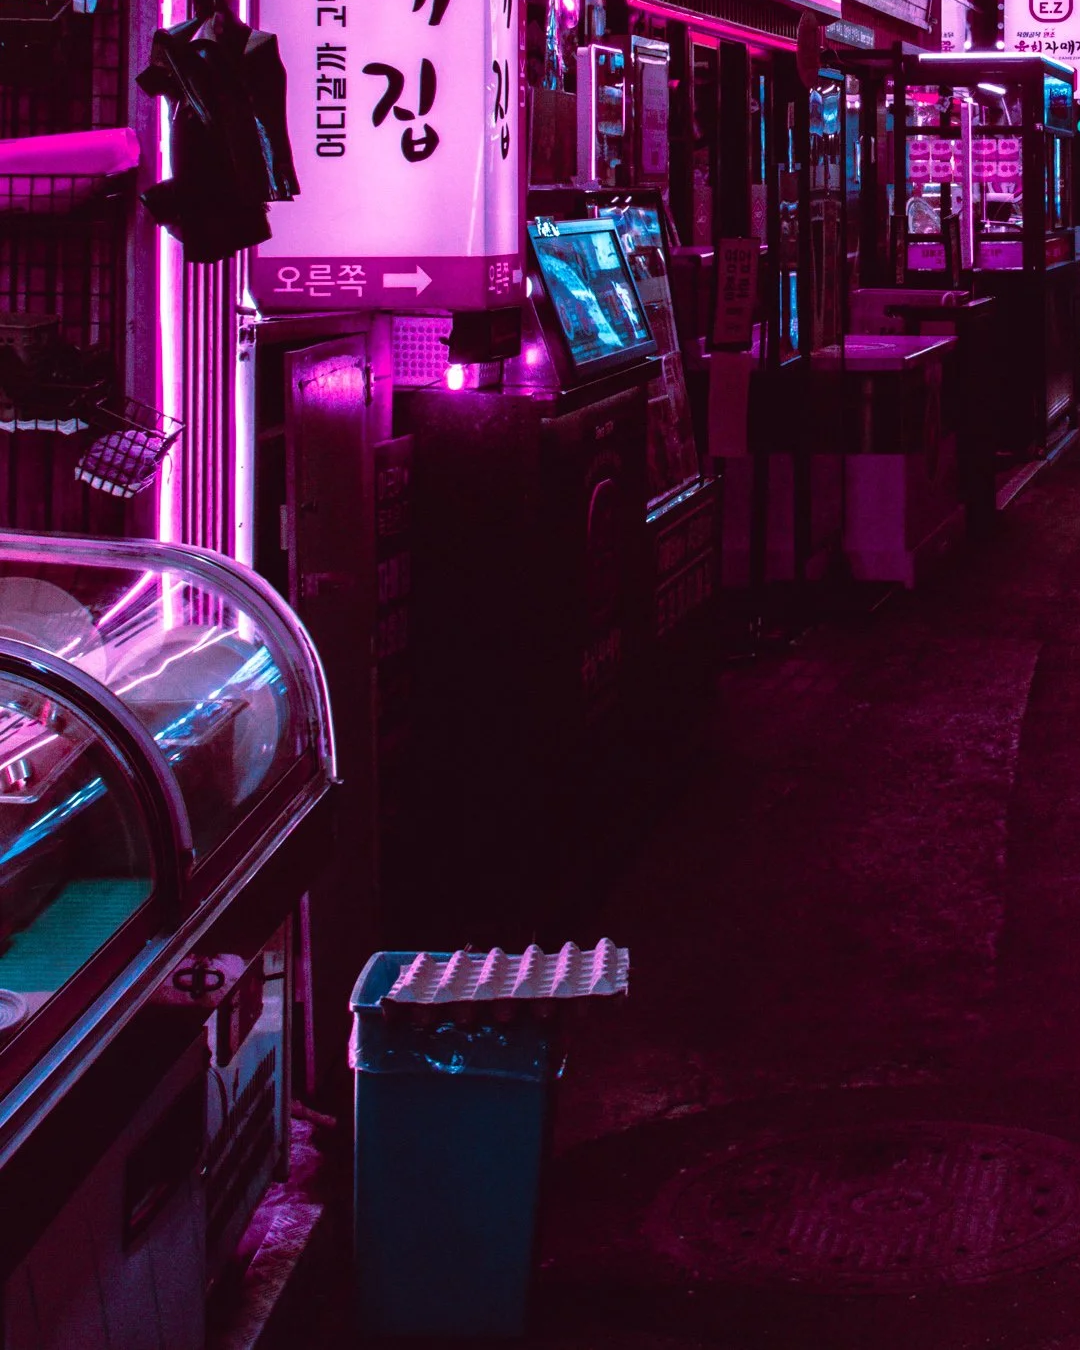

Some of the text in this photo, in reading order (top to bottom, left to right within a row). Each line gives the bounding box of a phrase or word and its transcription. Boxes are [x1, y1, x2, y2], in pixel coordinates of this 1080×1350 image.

[1039, 1, 1063, 14] E.Z
[315, 43, 348, 159] 어디갈까
[272, 264, 368, 298] 오른쪽
